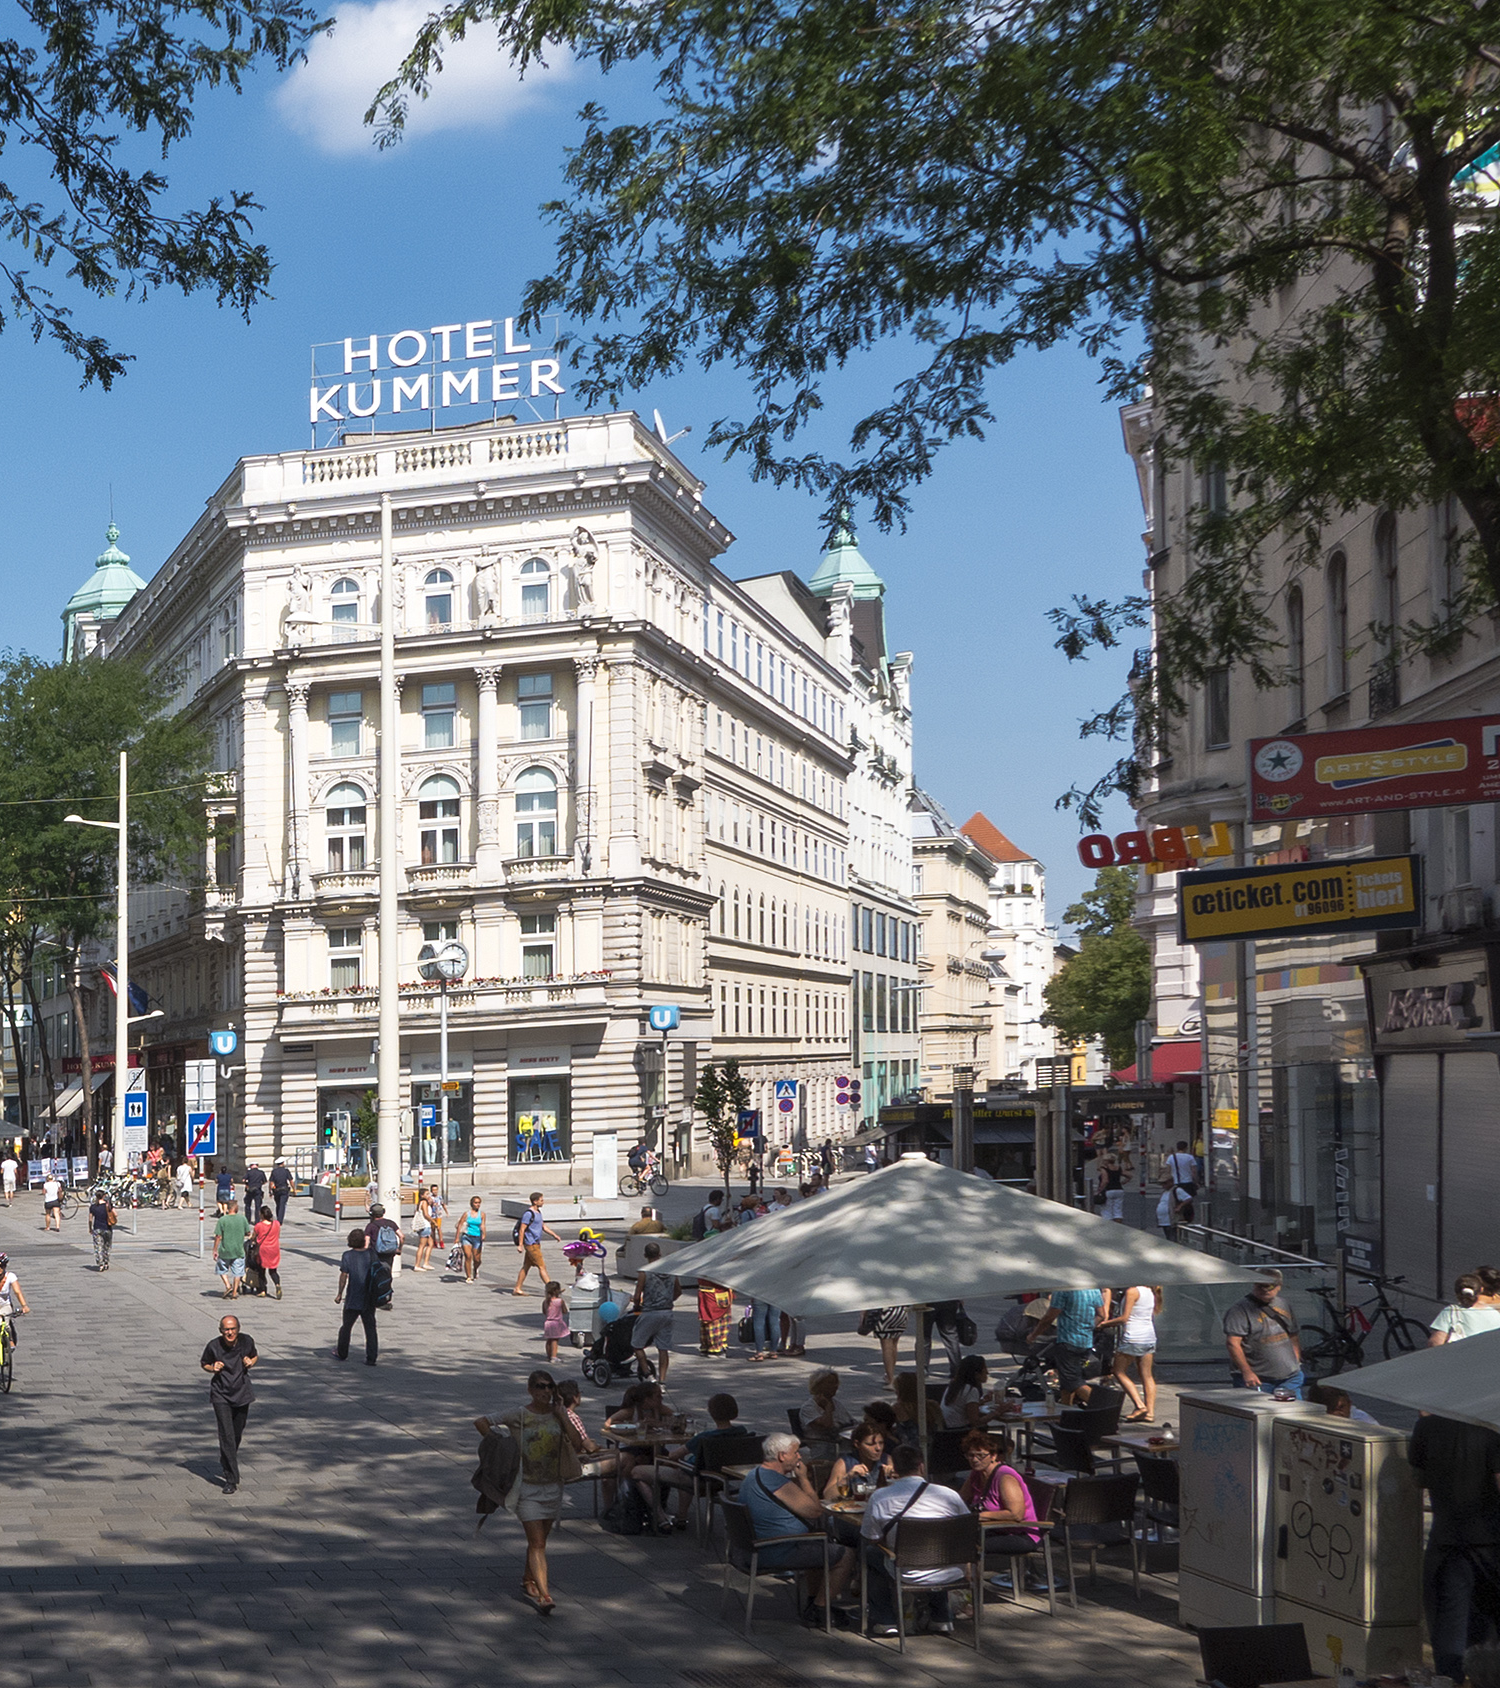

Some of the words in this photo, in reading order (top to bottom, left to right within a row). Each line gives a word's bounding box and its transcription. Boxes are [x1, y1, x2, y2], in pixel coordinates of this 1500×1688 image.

[344, 317, 531, 374] HOTEL
[310, 358, 566, 423] KUMMER
[1391, 752, 1458, 768] STYLE
[1355, 871, 1403, 887] Tickets
[1356, 886, 1404, 910] hier!
